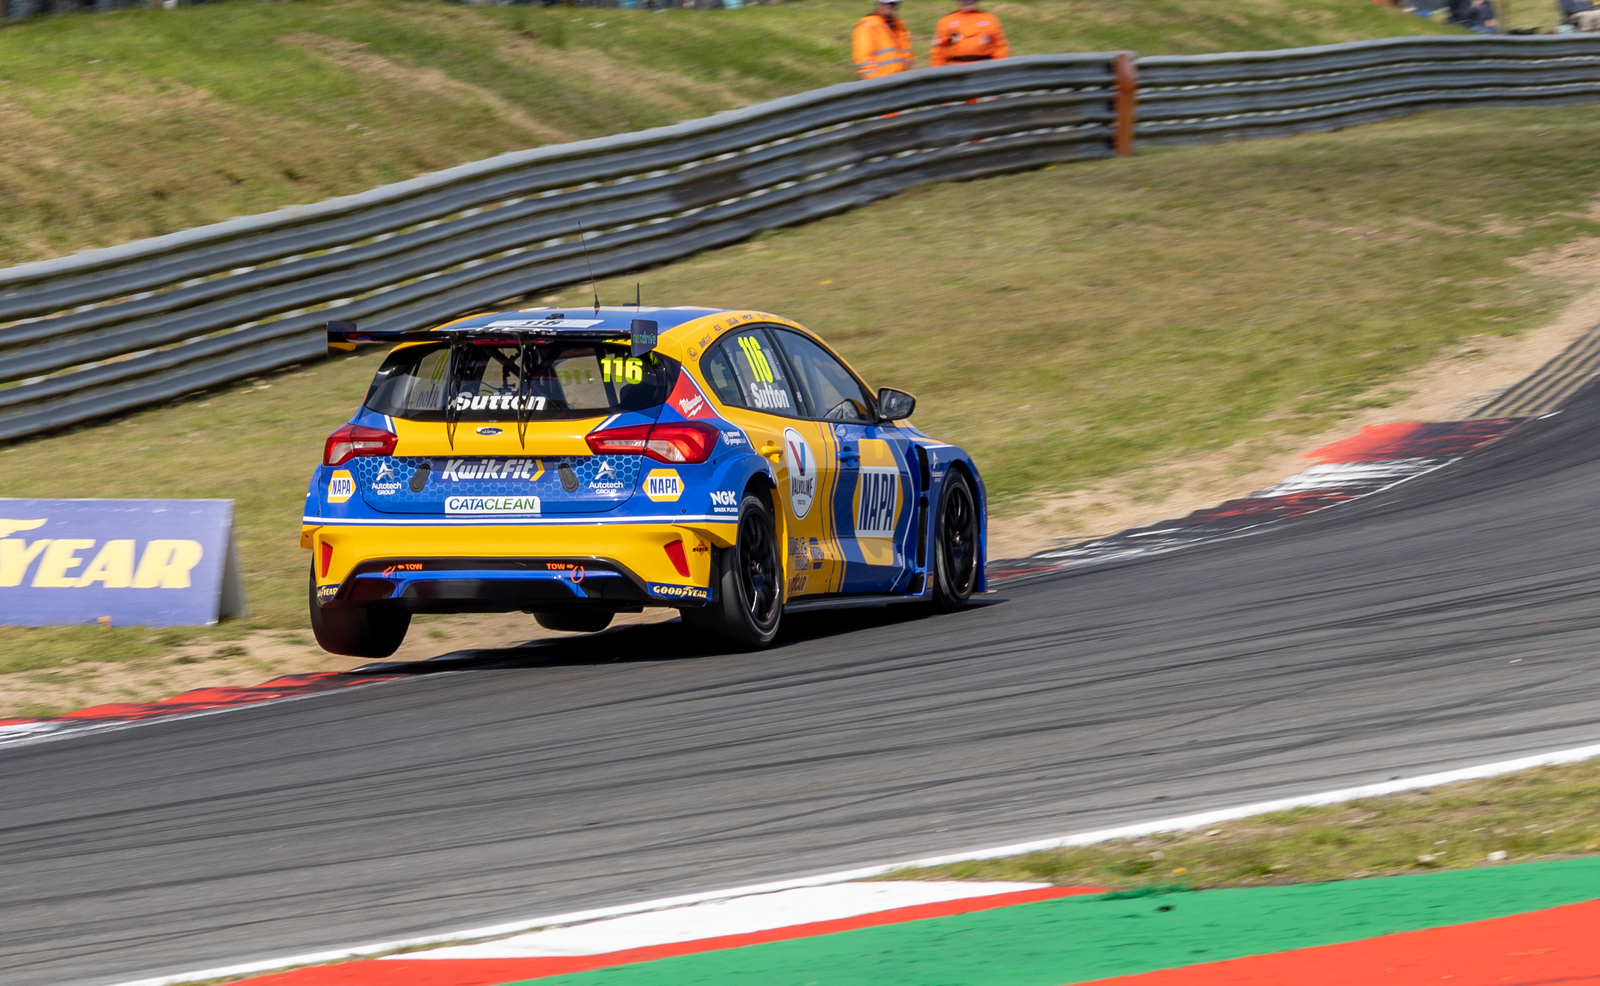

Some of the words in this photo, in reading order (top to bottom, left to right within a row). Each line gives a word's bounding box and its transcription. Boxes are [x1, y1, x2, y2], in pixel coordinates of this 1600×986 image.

[738, 336, 773, 383] 116
[601, 357, 643, 384] 116
[456, 392, 546, 410] Sutton
[750, 382, 790, 408] Sutton
[331, 479, 351, 495] NAPA
[371, 482, 402, 490] Autotech
[588, 481, 624, 489] Autotech
[650, 478, 678, 494] NAPA
[791, 475, 813, 498] VALVOLINE
[449, 498, 536, 511] CATACLEAN
[709, 490, 737, 506] NGK
[858, 473, 897, 531] NAPA
[404, 563, 423, 571] TOW
[653, 585, 708, 599] GOODYEAR
